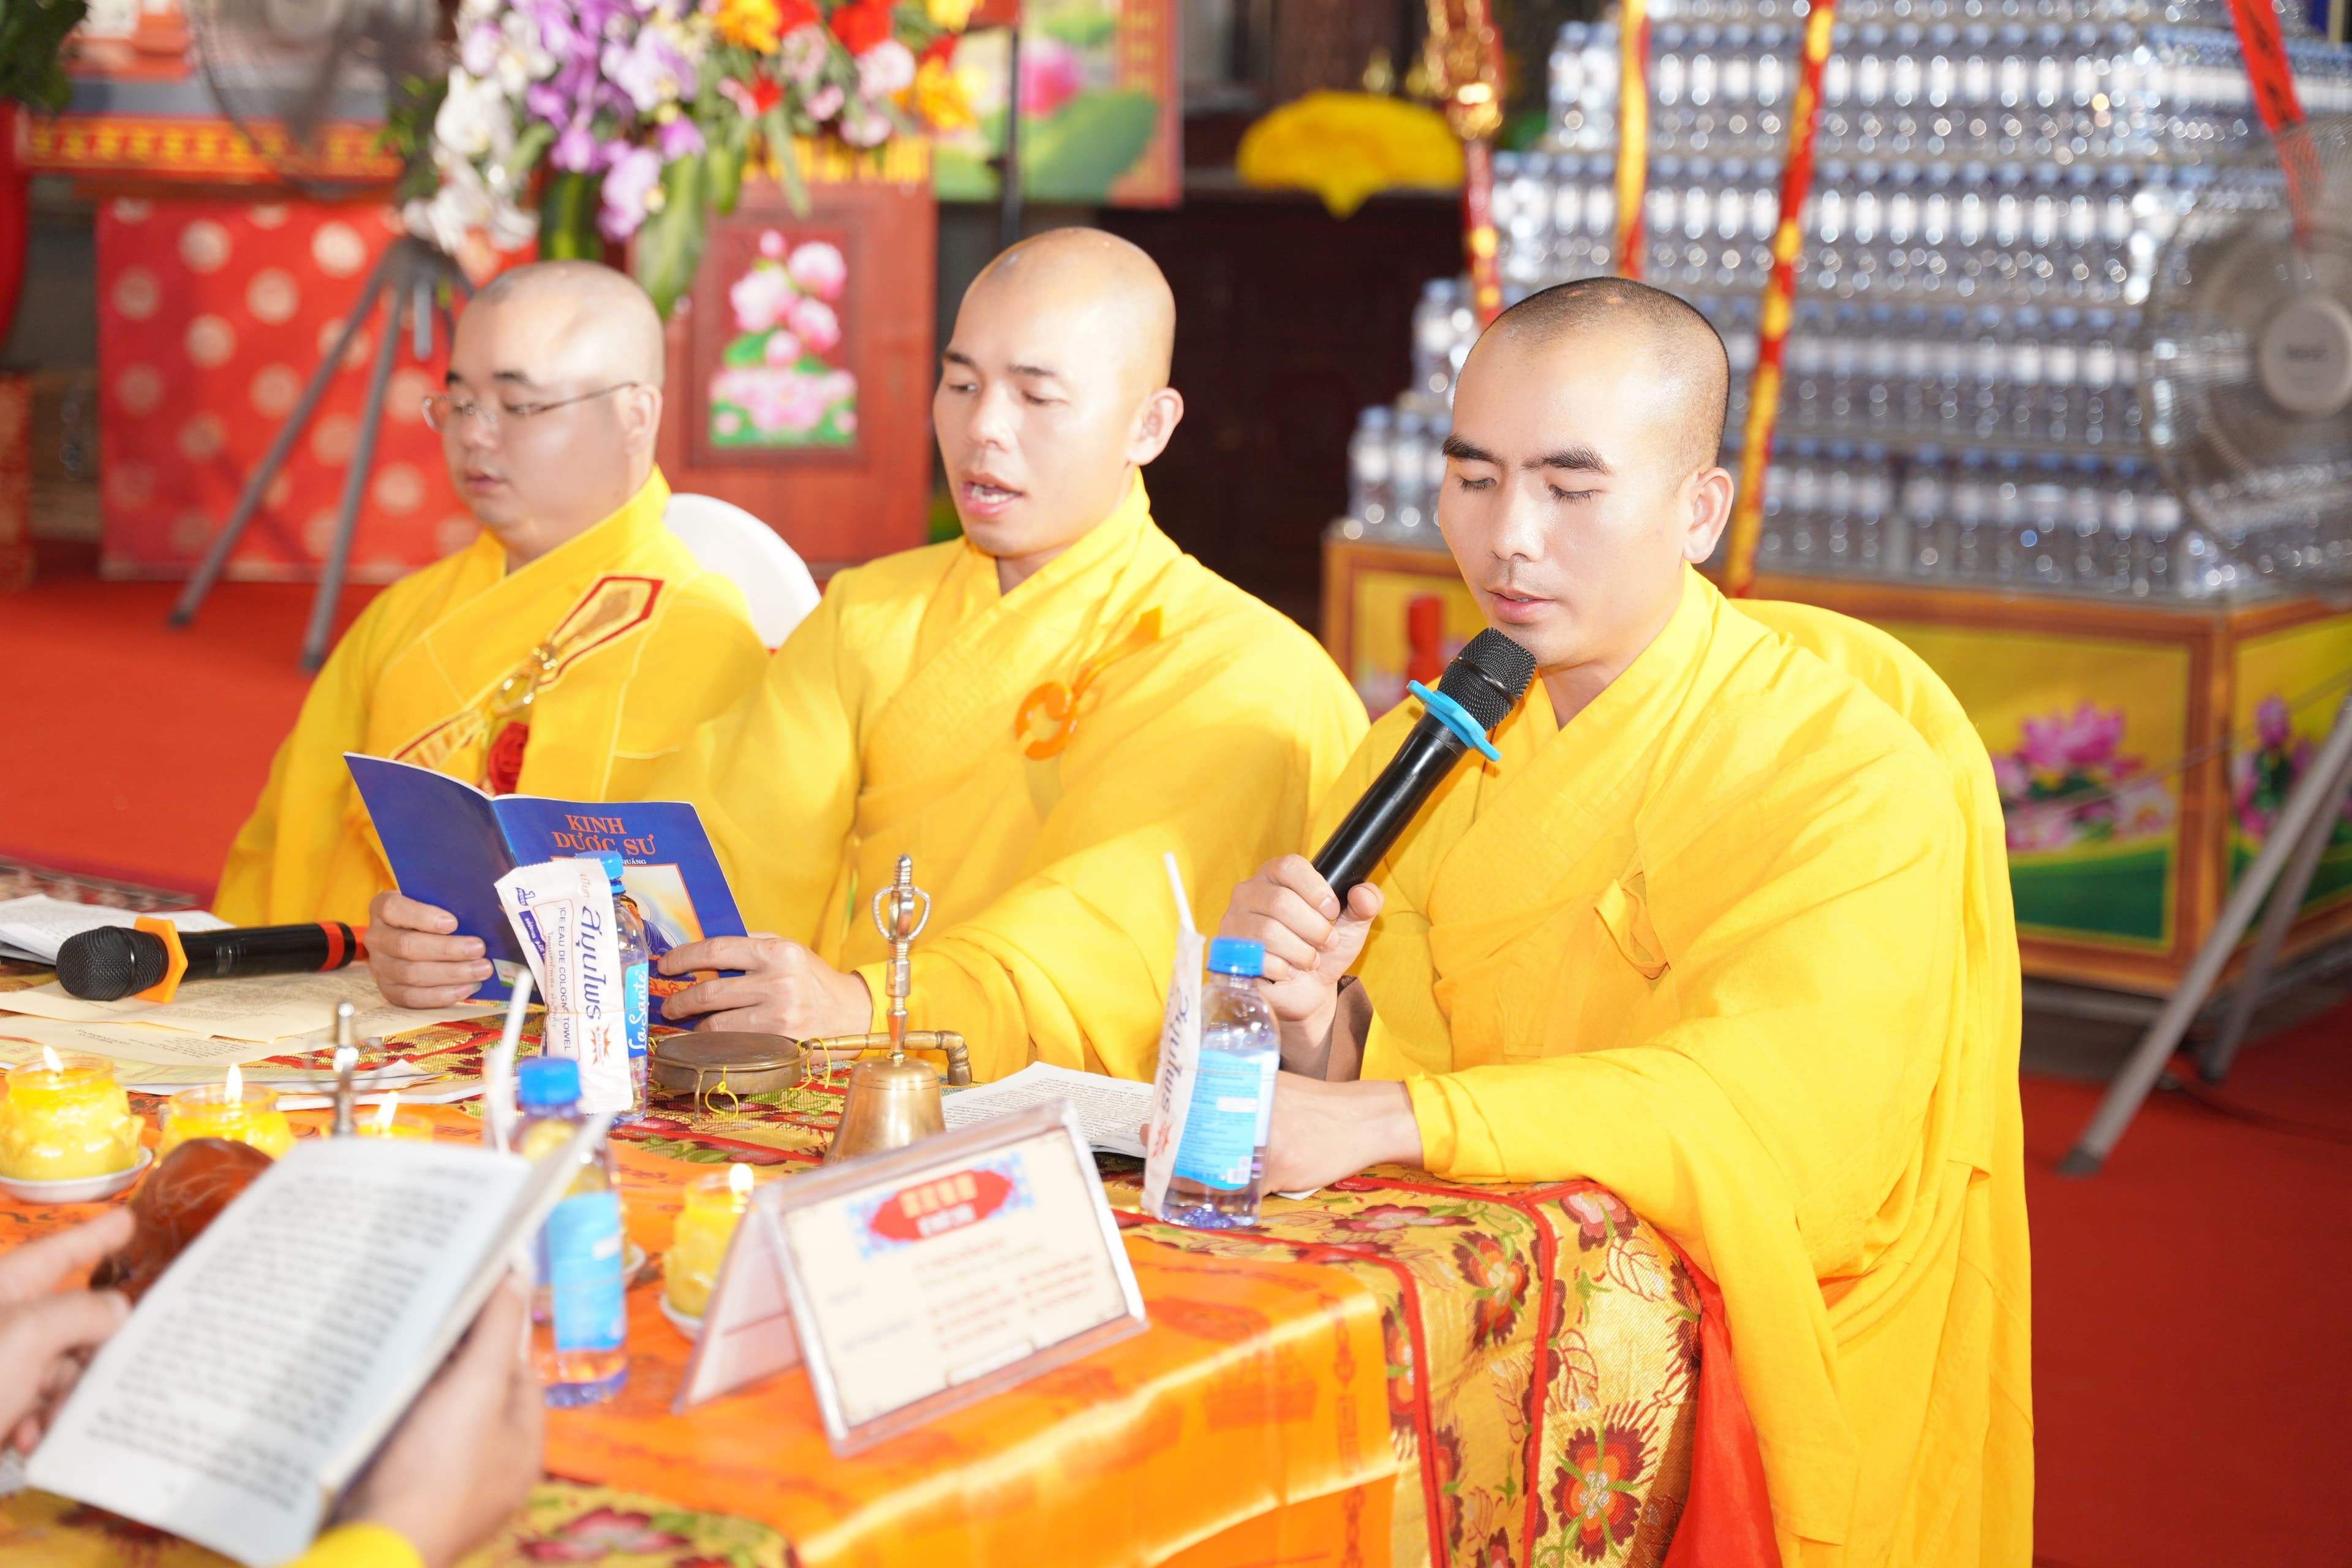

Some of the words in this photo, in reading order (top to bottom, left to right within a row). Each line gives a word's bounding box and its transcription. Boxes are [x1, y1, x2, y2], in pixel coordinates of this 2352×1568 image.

[565, 814, 627, 834] KINH
[623, 834, 657, 856] SƯ
[558, 907, 567, 921] ICE
[558, 951, 565, 963] DE
[575, 905, 606, 1020] สมุนไพร
